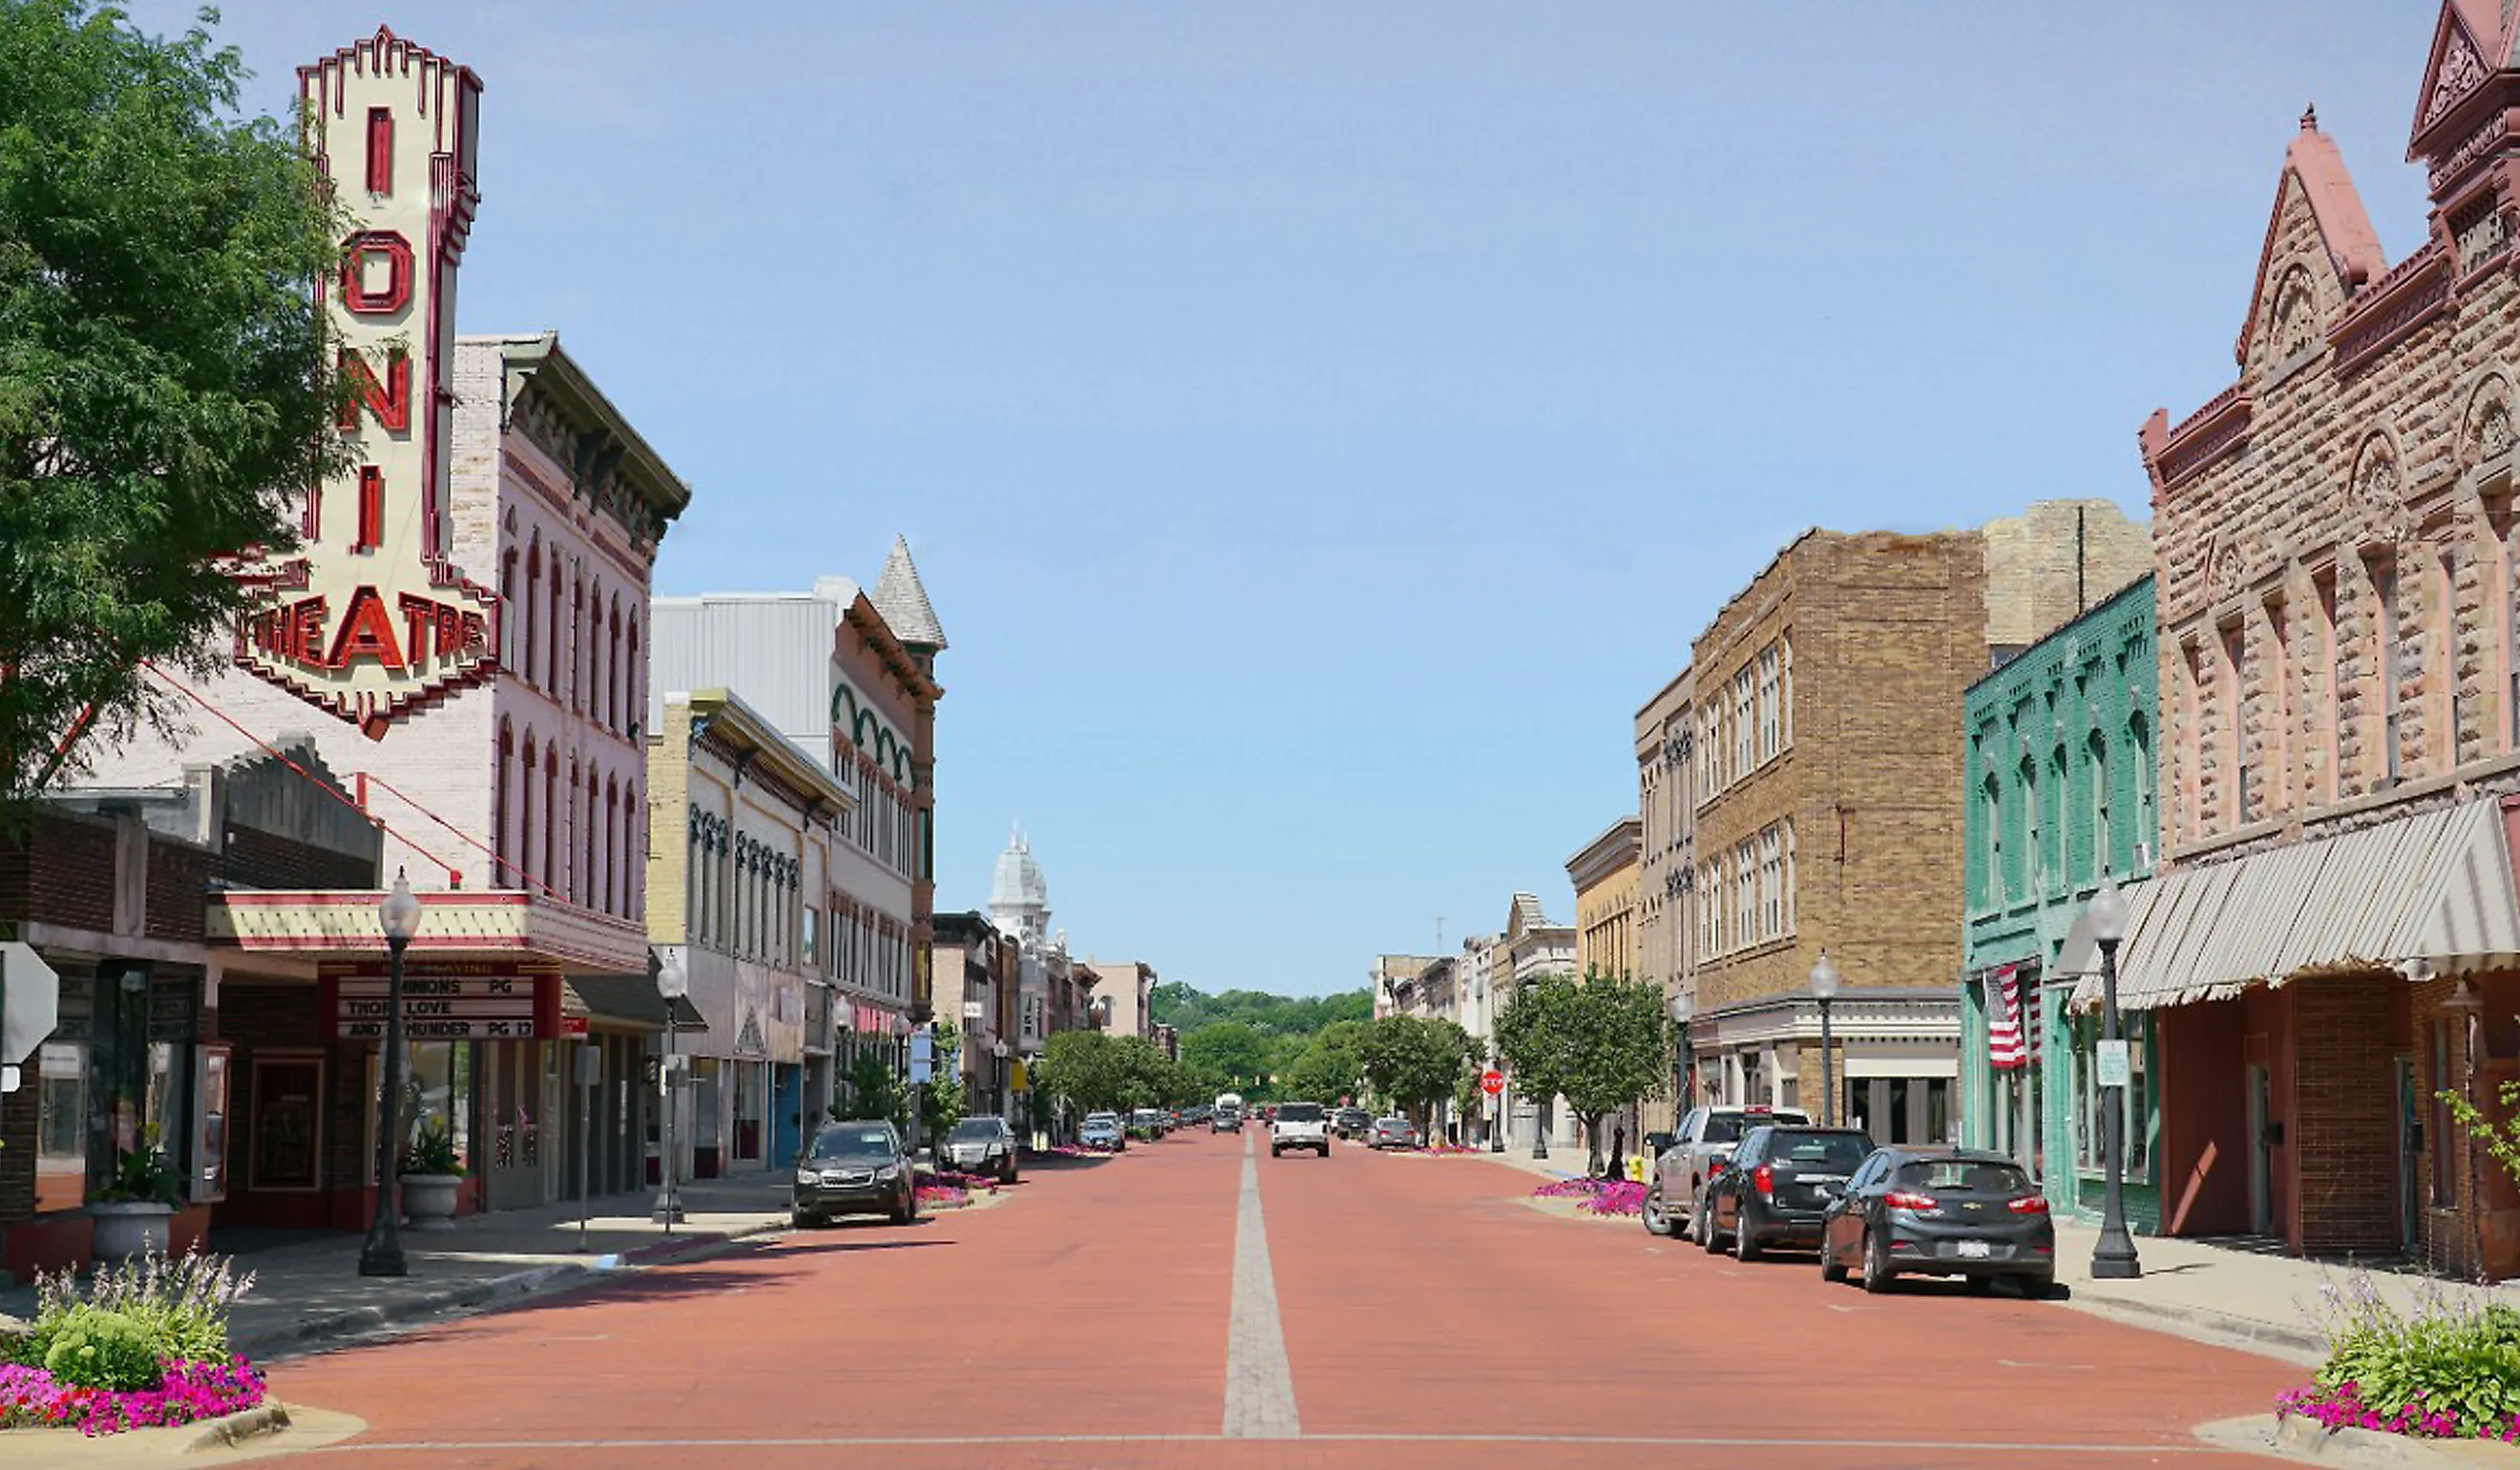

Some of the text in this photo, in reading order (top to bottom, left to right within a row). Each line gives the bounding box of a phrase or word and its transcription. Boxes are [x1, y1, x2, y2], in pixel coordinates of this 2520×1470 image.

[490, 980, 512, 994] PG
[406, 1002, 451, 1015] LOVE
[349, 1023, 381, 1036] AND
[391, 1021, 471, 1036] HUNDER
[488, 1022, 510, 1037] PG
